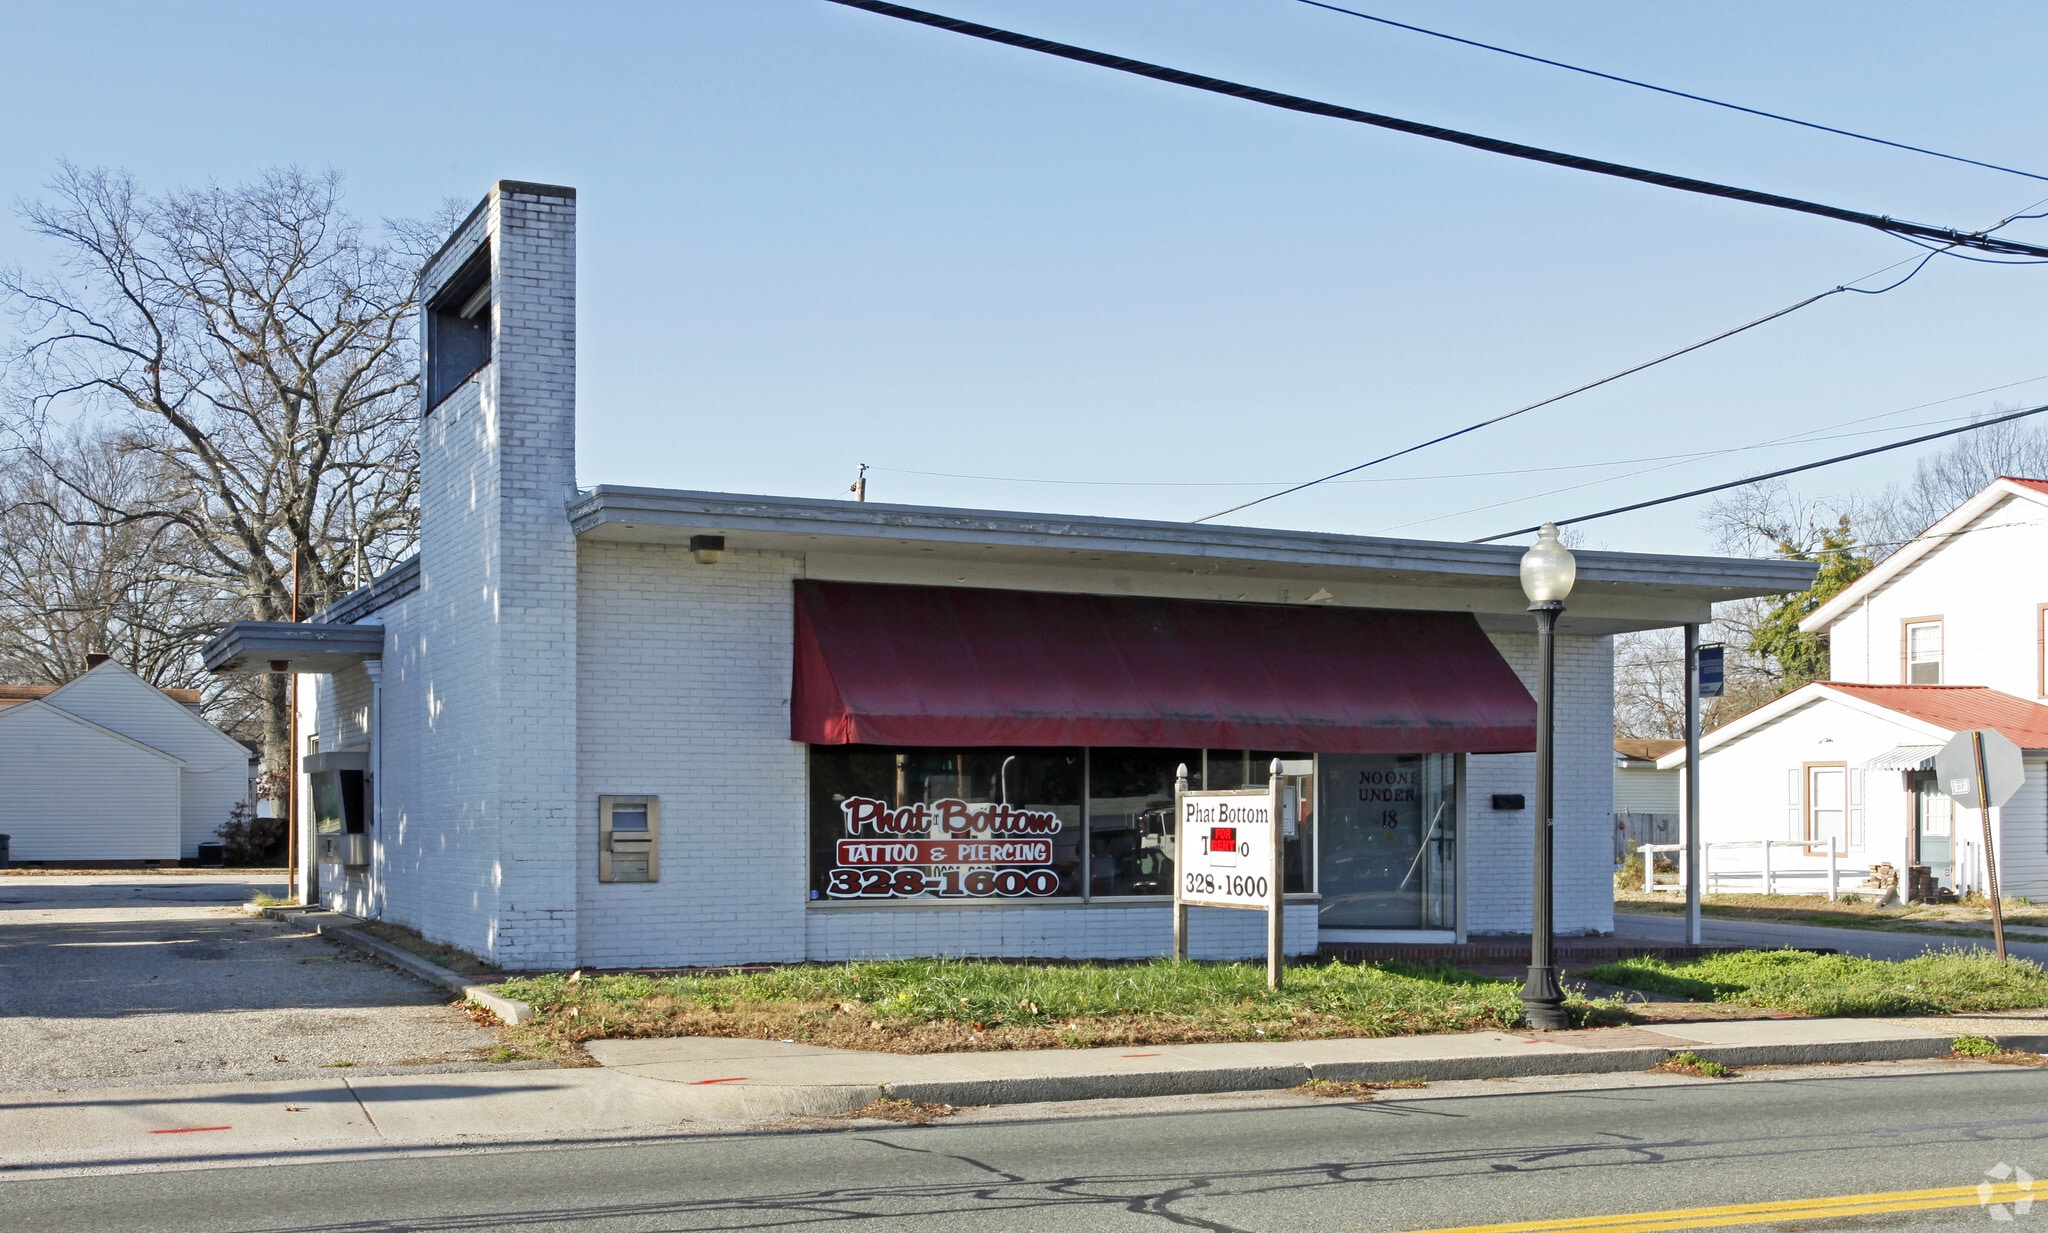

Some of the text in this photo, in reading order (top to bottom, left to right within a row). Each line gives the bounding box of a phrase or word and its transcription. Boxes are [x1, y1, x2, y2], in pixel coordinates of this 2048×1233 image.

[1359, 788, 1415, 802] UNDER
[842, 797, 1062, 834] Phat Bottom
[1186, 803, 1269, 823] Phat Bottom
[1382, 810, 1397, 829] 18
[1214, 828, 1232, 839] FOR
[842, 843, 1047, 862] TATTOO & PIERCING
[1211, 840, 1235, 851] RENT
[828, 868, 1060, 896] 328-1600
